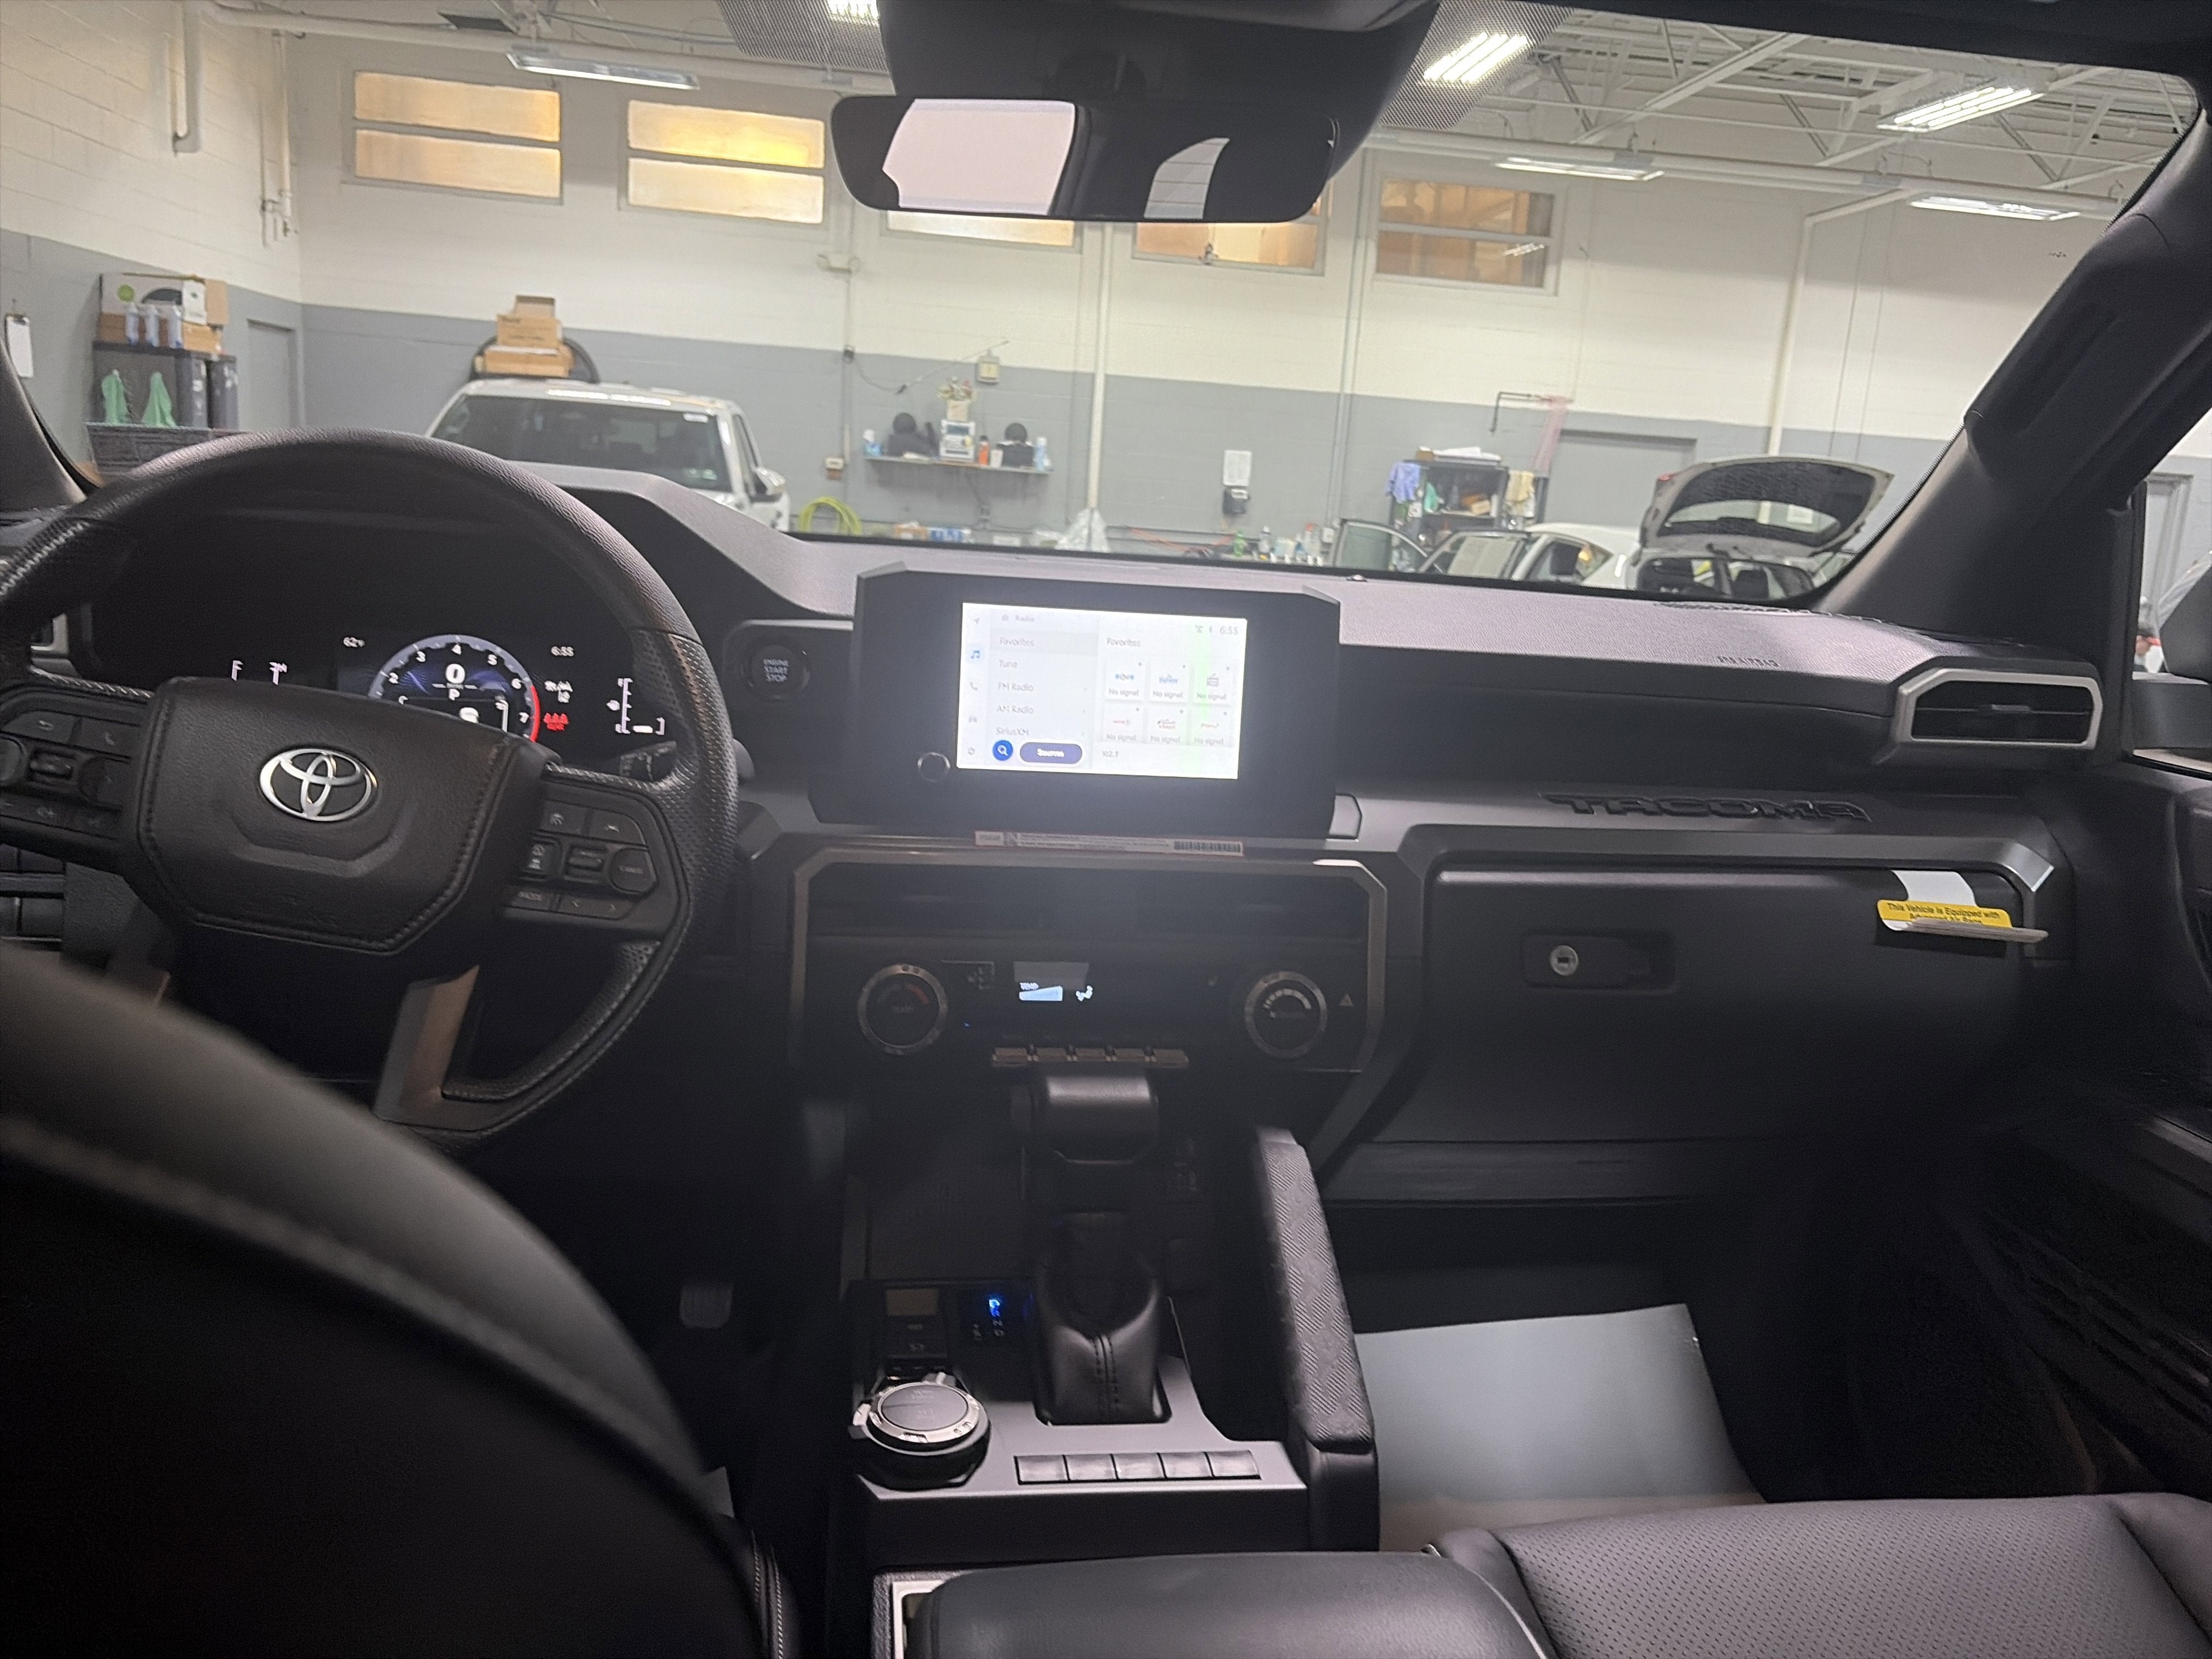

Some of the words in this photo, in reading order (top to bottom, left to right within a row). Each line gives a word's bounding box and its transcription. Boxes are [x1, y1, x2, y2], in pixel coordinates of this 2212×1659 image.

[1220, 626, 1238, 635] 6:55
[1000, 637, 1035, 647] Favorites
[1107, 637, 1141, 647] Favorites
[999, 659, 1018, 668] Tune
[998, 682, 1010, 691] FM
[1011, 683, 1034, 692] Radio
[1164, 691, 1183, 699] signal
[997, 704, 1010, 713] AM
[1011, 706, 1034, 714] Radio
[996, 727, 1029, 736] SiriusXM
[1118, 735, 1137, 743] signal
[1161, 736, 1181, 744] signal
[1205, 738, 1224, 746] signal
[1547, 794, 1872, 823] TACOMA
[1887, 902, 1905, 911] This
[1906, 904, 1934, 913] Vehicle
[1944, 907, 1982, 918] Equipped
